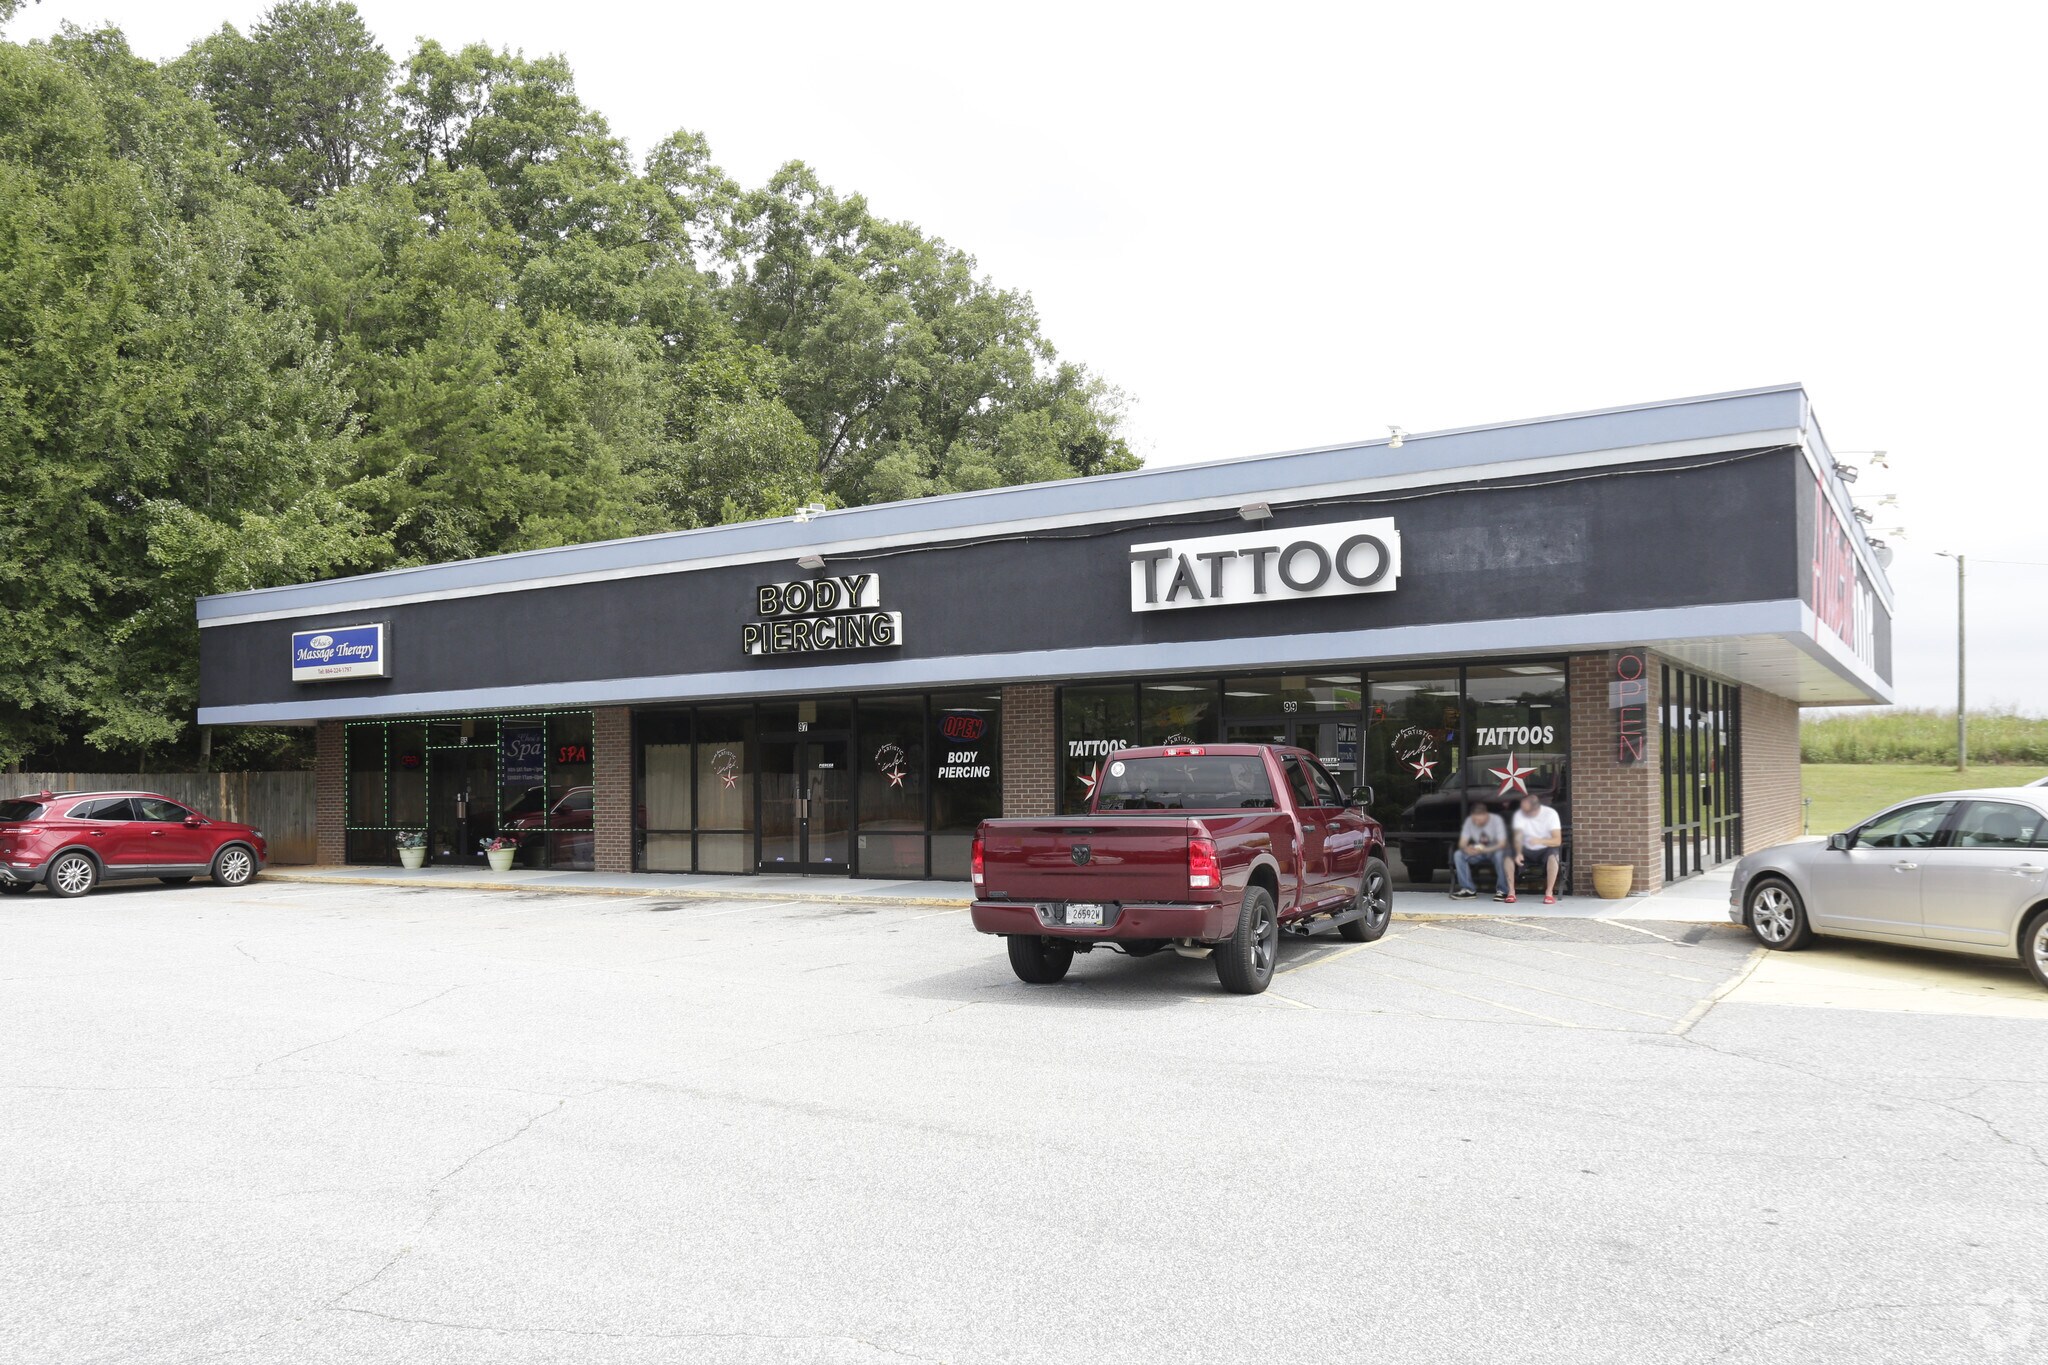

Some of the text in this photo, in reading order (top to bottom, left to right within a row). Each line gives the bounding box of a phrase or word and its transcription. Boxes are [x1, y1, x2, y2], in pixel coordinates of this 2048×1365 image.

[1128, 534, 1391, 604] TATTOO
[757, 574, 871, 617] BODY
[741, 612, 895, 655] PIERCING
[297, 642, 374, 662] Massage Therapy
[1283, 701, 1298, 713] 99
[1616, 654, 1643, 762] OPEN
[944, 716, 983, 739] OPEN
[1403, 729, 1433, 741] ARTISTIC
[1476, 726, 1555, 746] TATTOOS
[507, 740, 542, 761] Spa
[559, 745, 586, 762] SPA
[947, 751, 979, 764] BODY
[1068, 739, 1127, 757] TATTOOS
[938, 766, 991, 778] PIERCING
